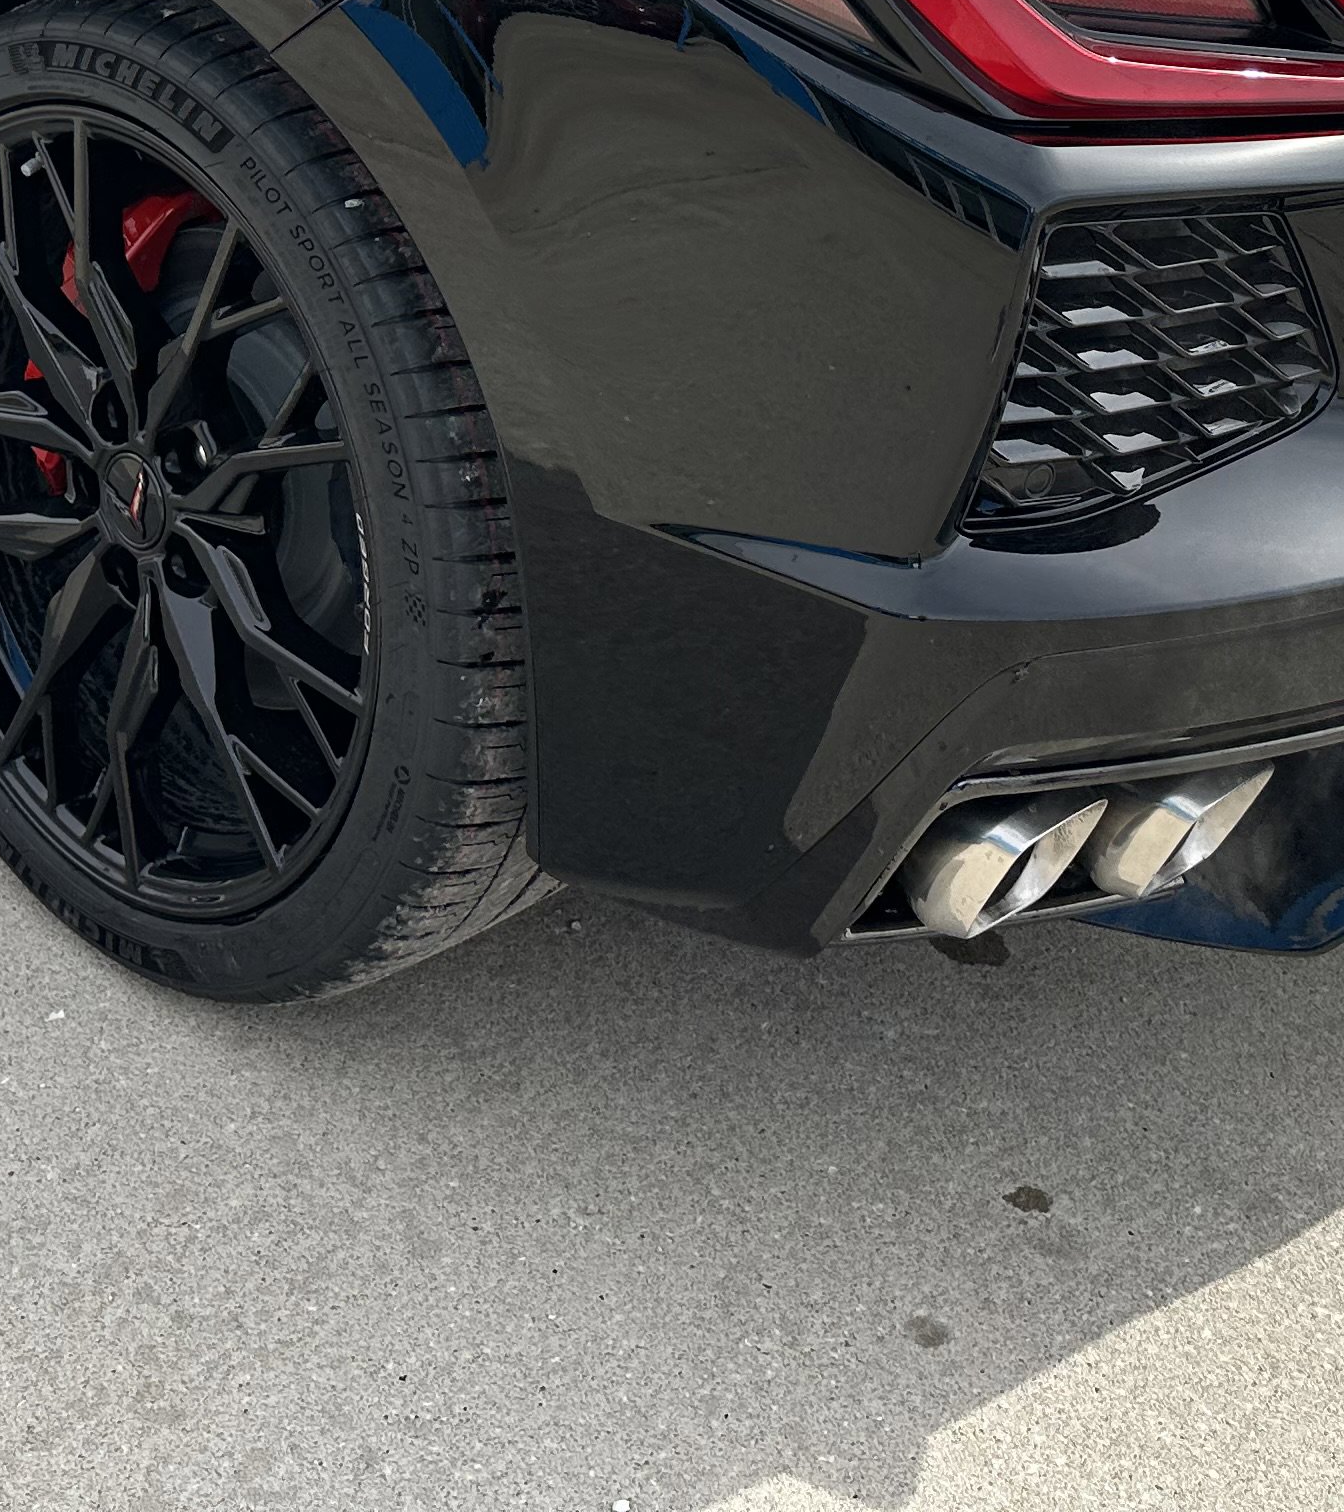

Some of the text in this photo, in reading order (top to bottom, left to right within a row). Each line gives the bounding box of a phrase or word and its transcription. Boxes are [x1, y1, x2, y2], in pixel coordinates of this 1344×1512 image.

[50, 42, 224, 143] MICHELIN
[239, 155, 292, 217] PILOT
[289, 223, 346, 306] SPORT
[338, 319, 371, 370] ALL
[363, 381, 410, 502] SEASON
[401, 538, 420, 576] ZP
